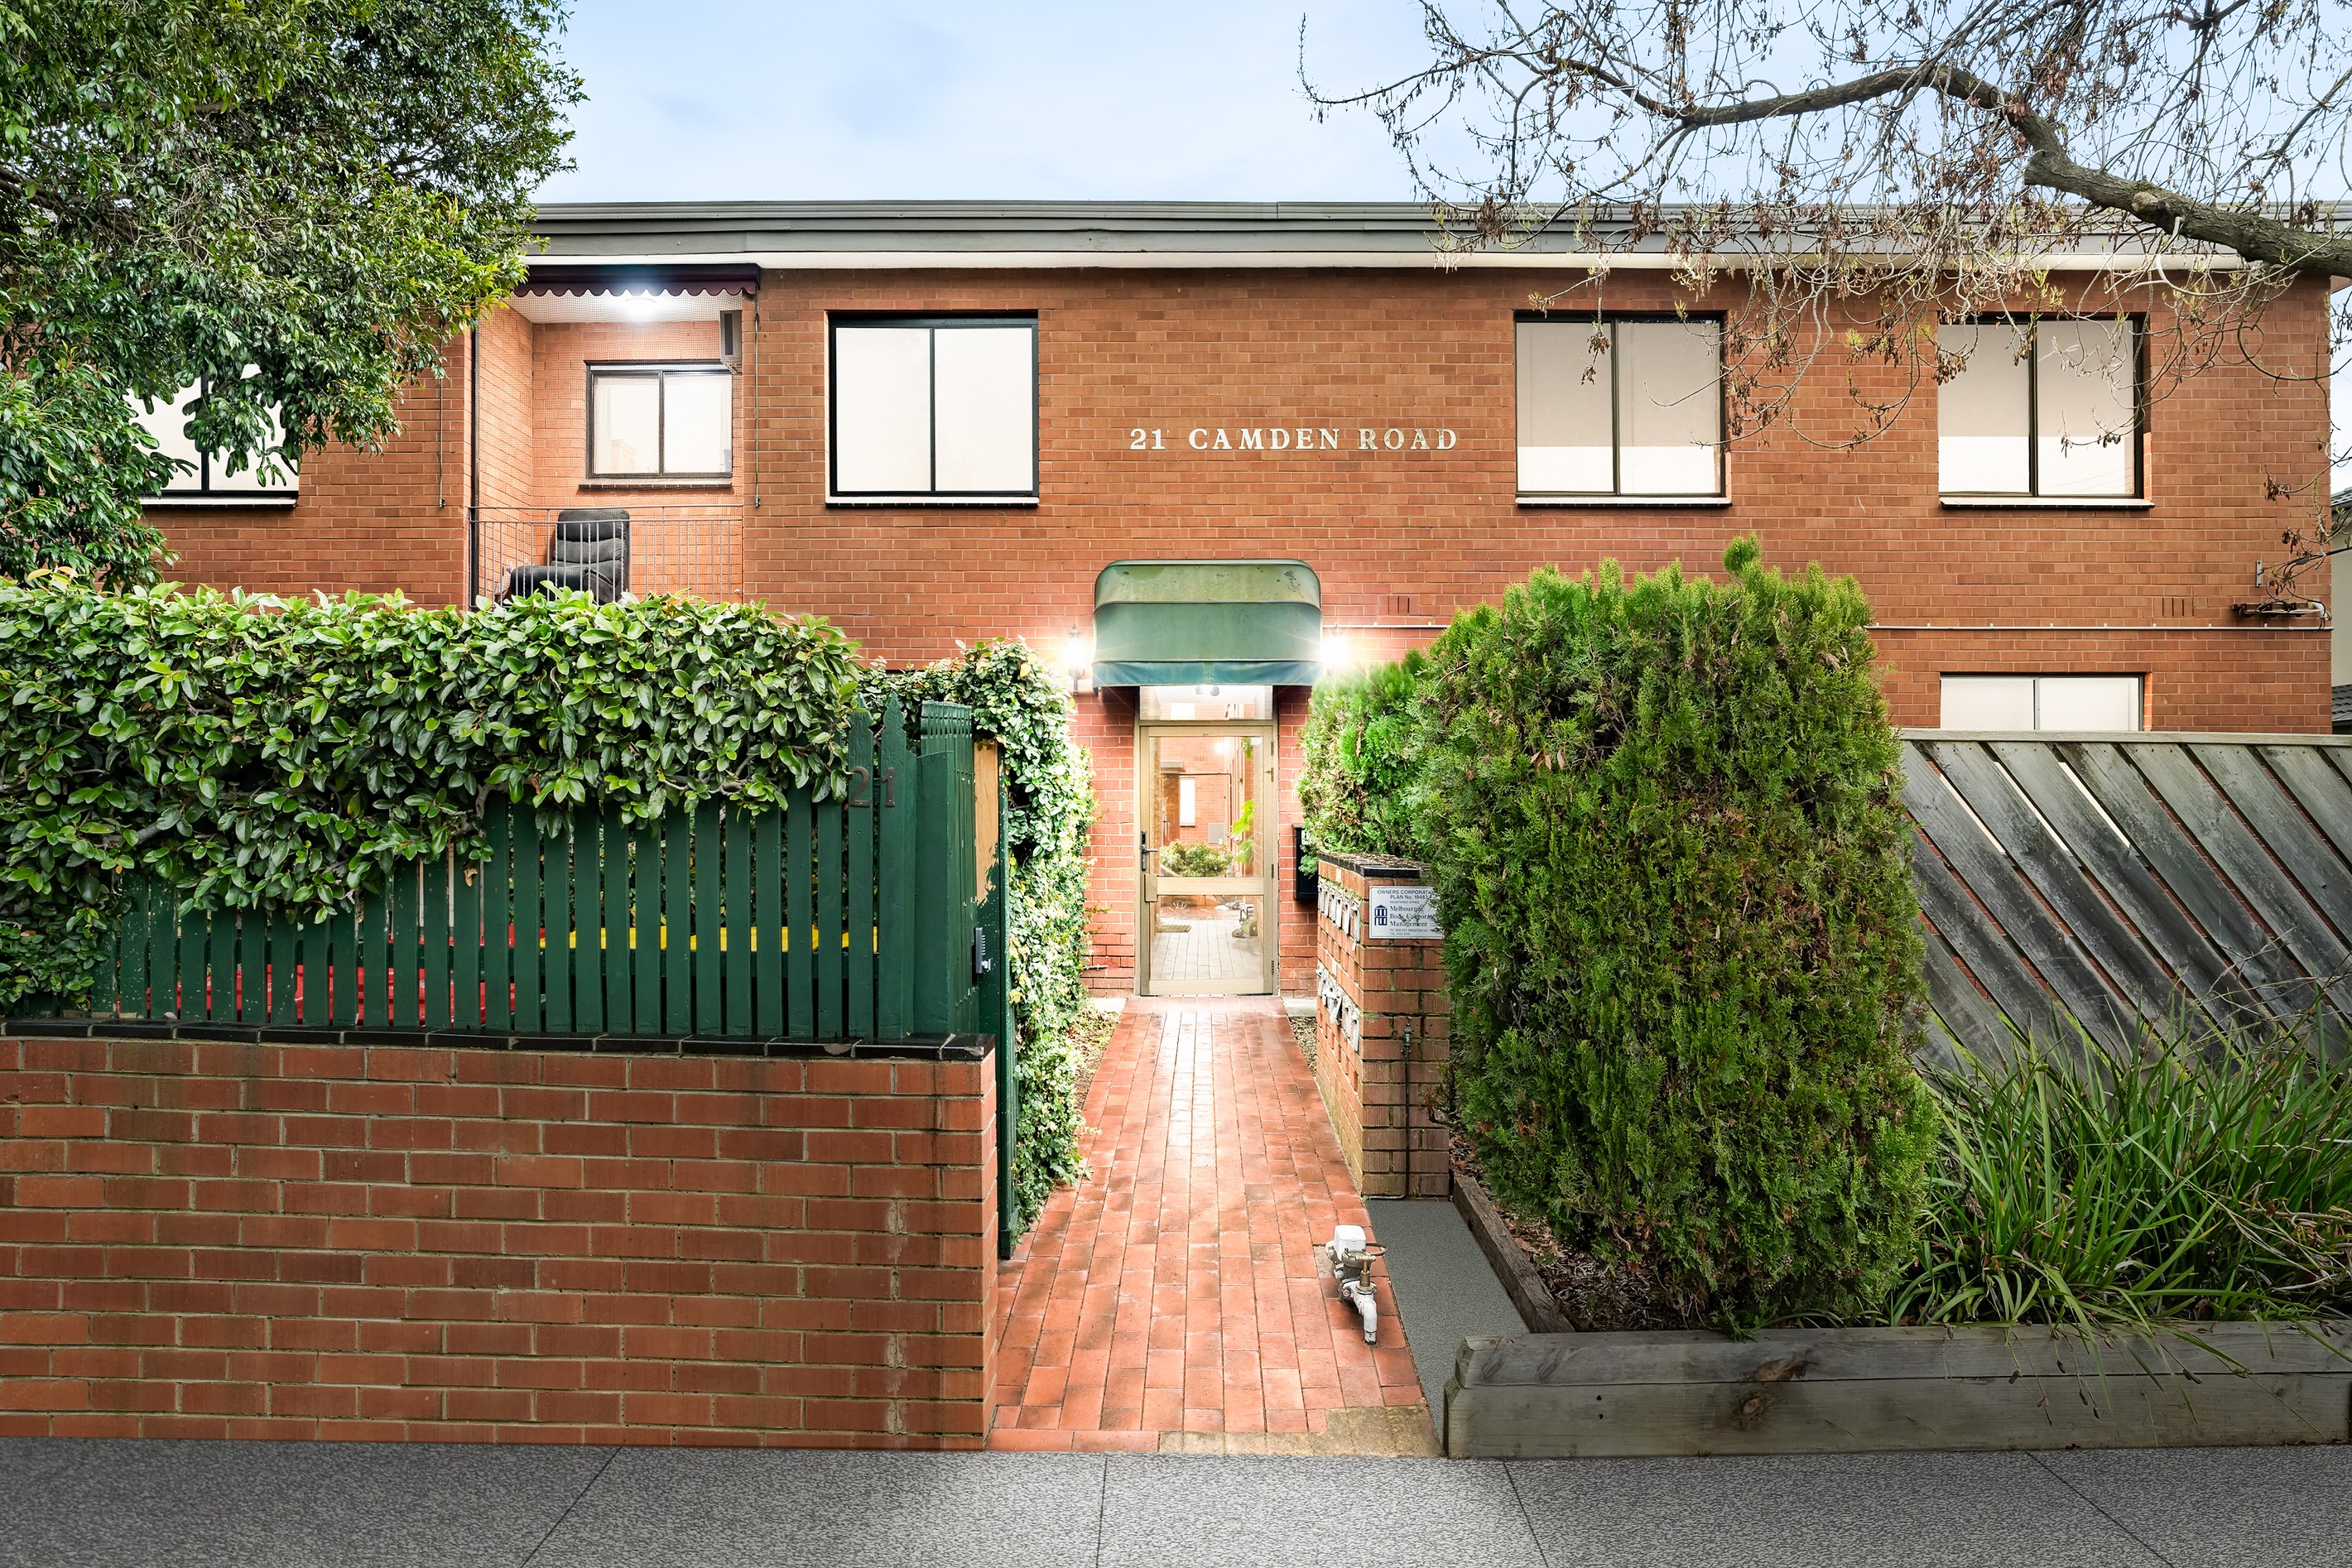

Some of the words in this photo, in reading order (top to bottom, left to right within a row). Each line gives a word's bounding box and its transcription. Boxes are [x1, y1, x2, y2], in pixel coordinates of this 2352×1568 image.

[1129, 428, 1166, 450] 21
[1188, 428, 1340, 450] CAMDEN
[1358, 428, 1458, 450] ROAD
[848, 766, 896, 808] 21
